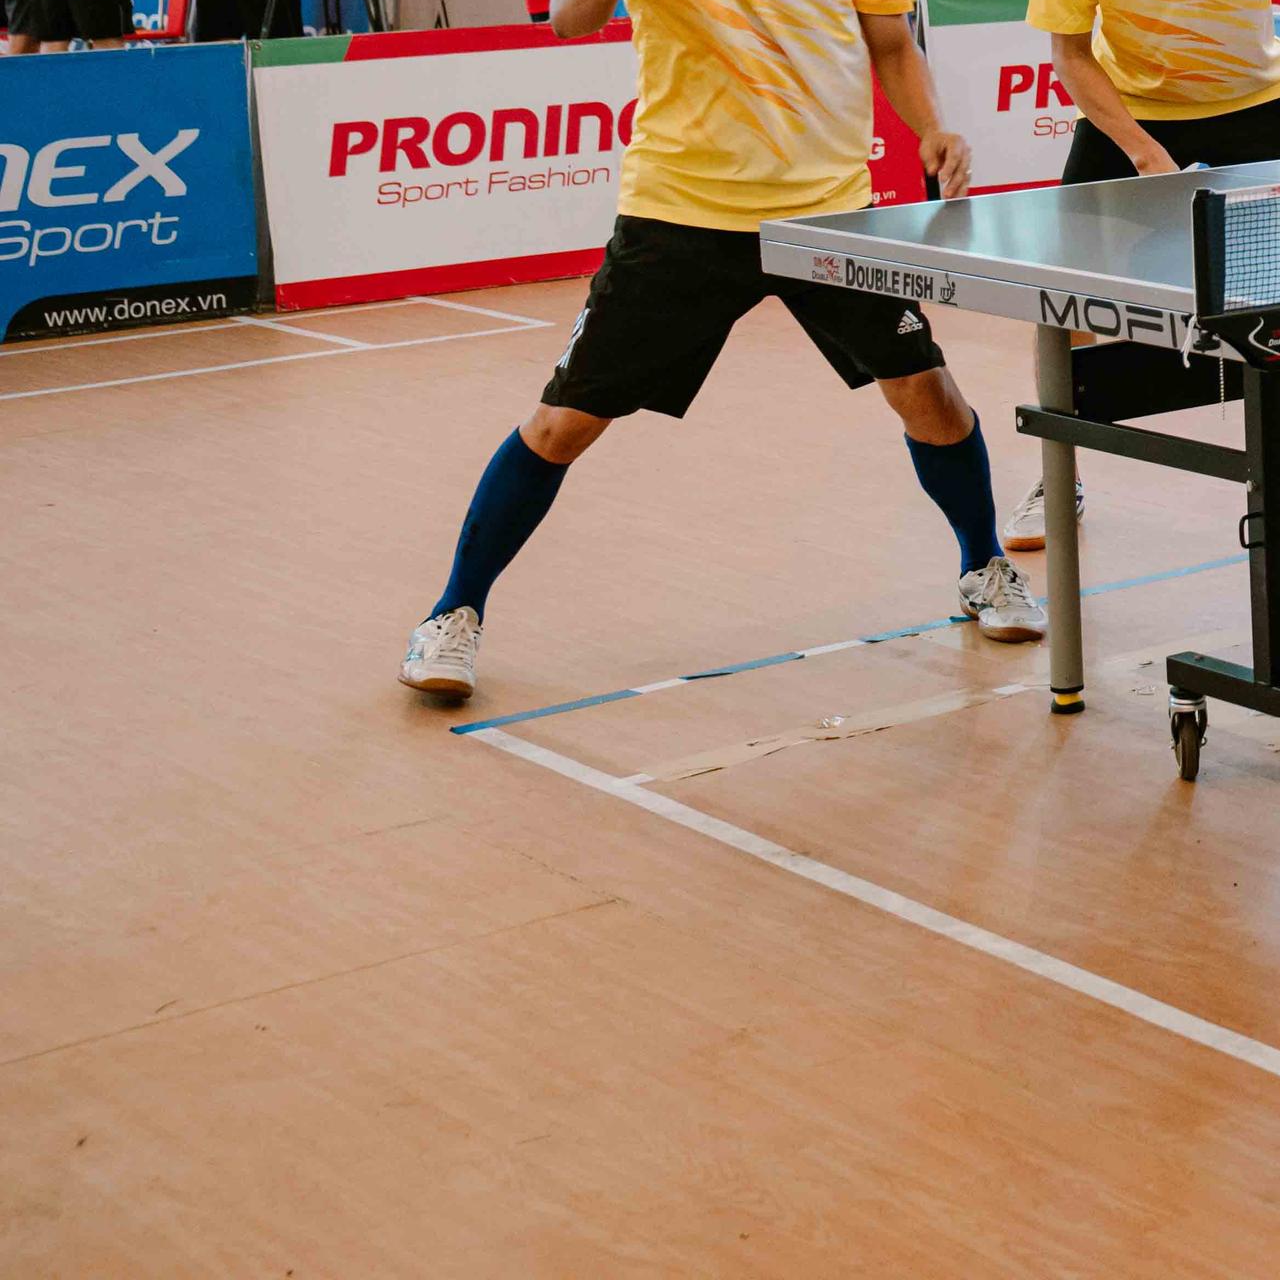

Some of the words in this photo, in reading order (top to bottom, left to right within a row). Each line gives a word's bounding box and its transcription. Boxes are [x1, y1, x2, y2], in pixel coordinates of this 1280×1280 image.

[376, 177, 480, 208] Sport
[487, 164, 611, 195] Fashion
[845, 258, 900, 295] DOUBLE
[903, 272, 934, 300] FISH
[44, 293, 227, 328] www.donex.vn
[1039, 289, 1194, 349] MOFI
